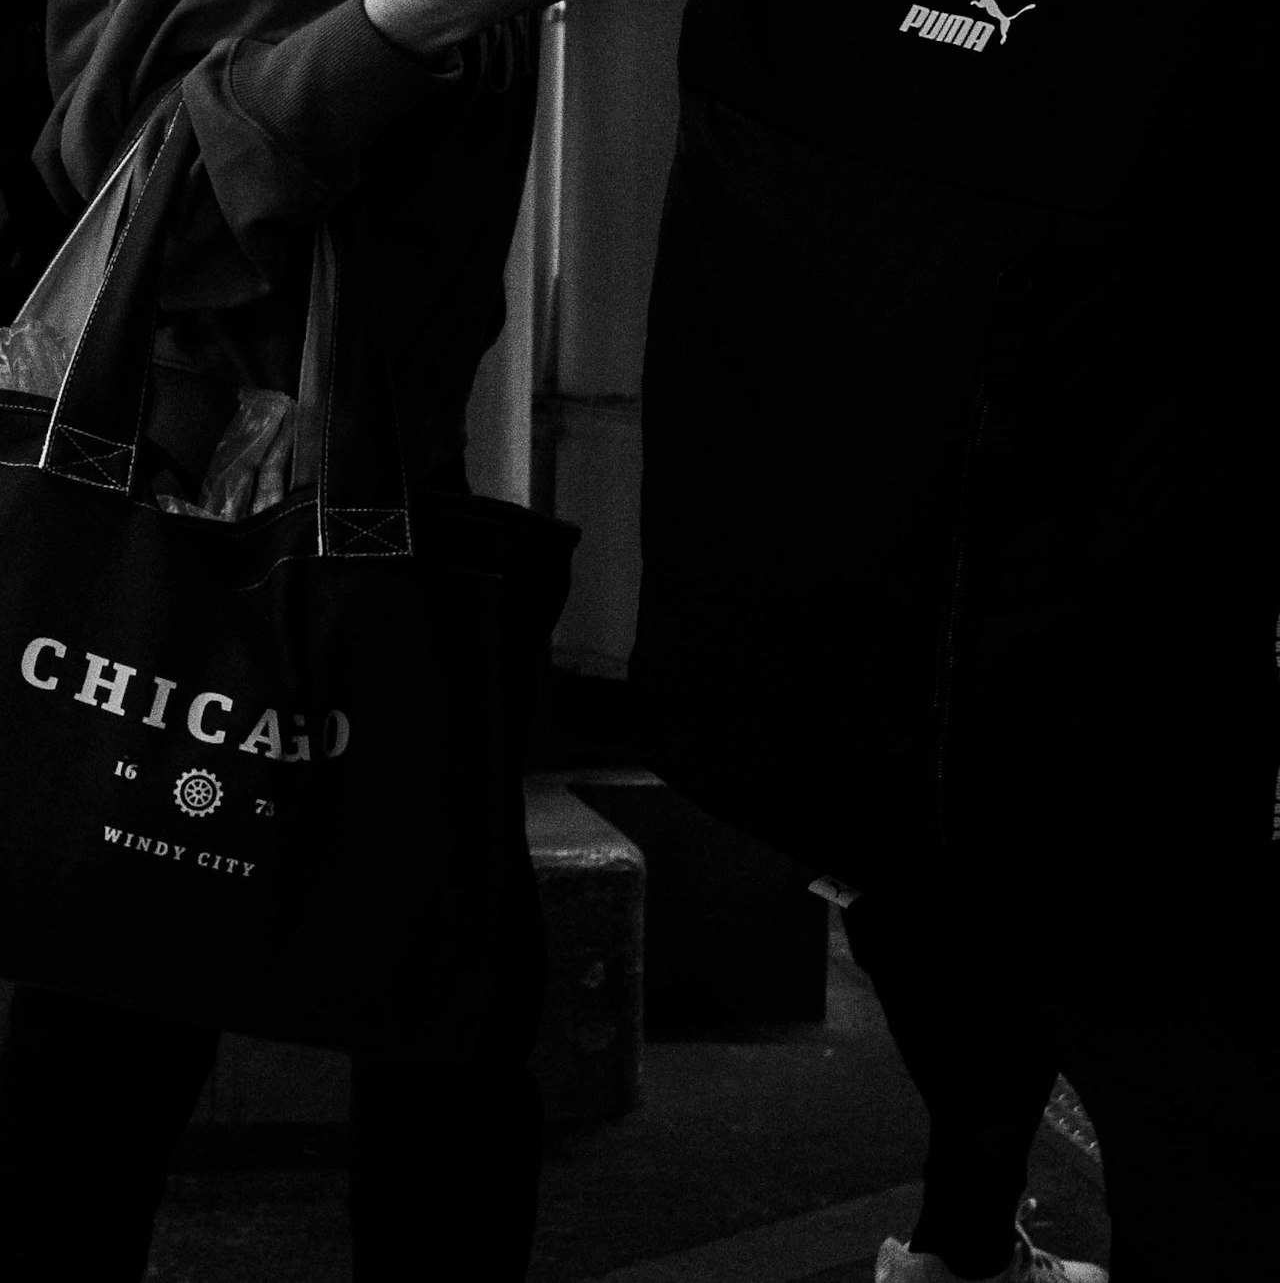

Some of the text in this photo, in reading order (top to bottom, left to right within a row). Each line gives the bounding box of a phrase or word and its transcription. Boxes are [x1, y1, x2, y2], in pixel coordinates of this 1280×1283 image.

[898, 3, 995, 53] PUMA
[113, 760, 140, 780] 16
[103, 825, 256, 878] WINDY CITY
